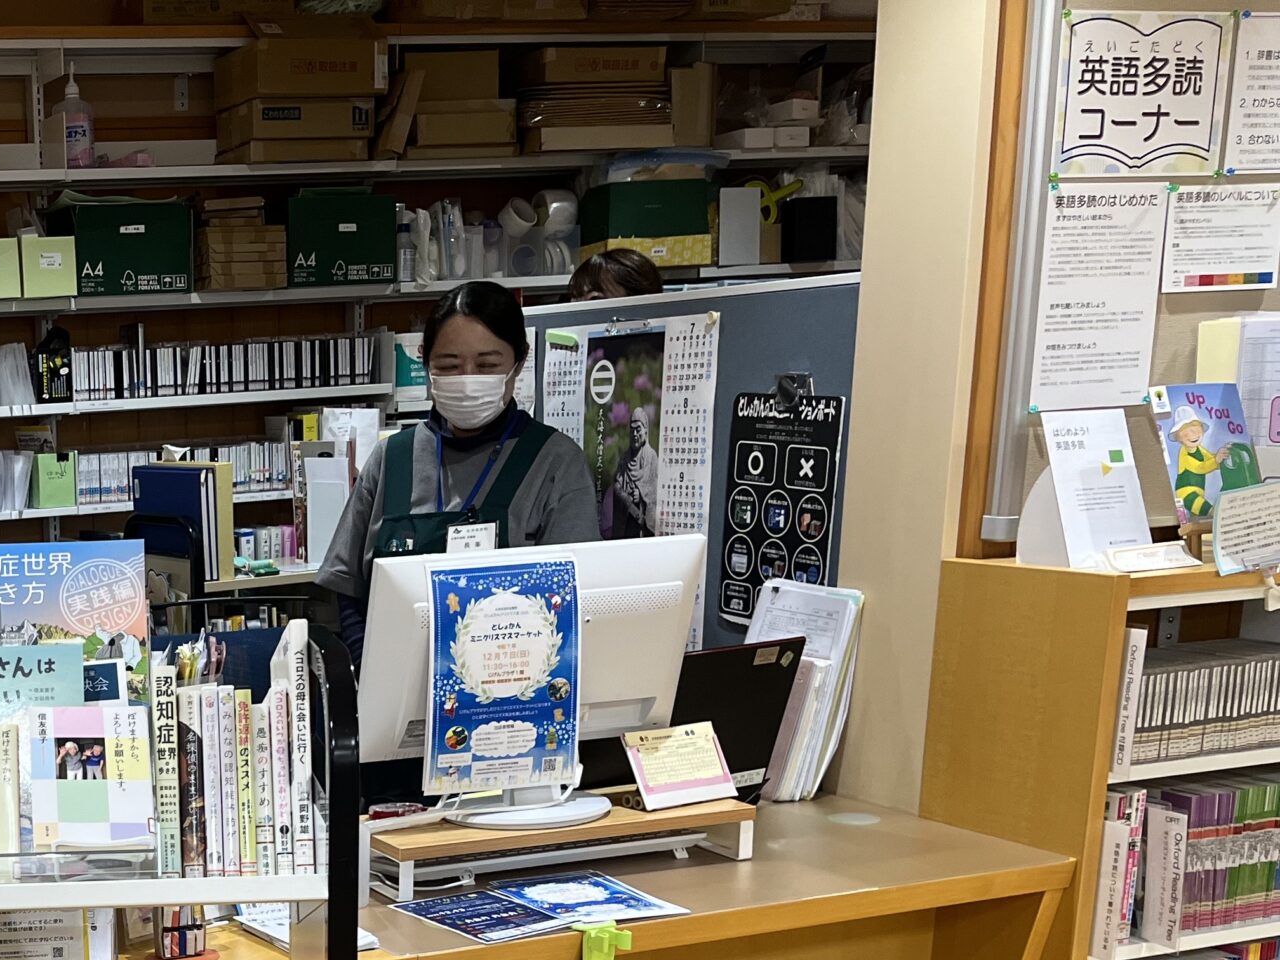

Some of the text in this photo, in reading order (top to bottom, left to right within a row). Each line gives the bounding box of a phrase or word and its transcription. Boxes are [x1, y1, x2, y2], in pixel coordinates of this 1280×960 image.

[1084, 40, 1204, 53] えいごたどく
[1077, 55, 1205, 96] 英語多読
[1078, 103, 1201, 143] コーナー
[1054, 193, 1159, 209] 英語多読のはじめかた
[1176, 189, 1280, 204] 英語多読のレベルについて
[294, 251, 317, 268] A4
[81, 260, 105, 278] A4
[683, 398, 689, 408] 8
[1185, 391, 1205, 409] Up
[1204, 404, 1231, 420] You
[1227, 419, 1244, 435] Go
[679, 472, 684, 482] 9
[68, 563, 122, 592] DIALOGUE
[67, 579, 136, 615] 実践編
[82, 605, 135, 631] DESIGN
[490, 622, 522, 632] としょかん
[469, 630, 543, 644] ミニクリスマスマーケット
[1120, 644, 1139, 733] Oxford Reading Tree
[155, 676, 176, 744] 認知症
[294, 649, 308, 765] ペコロスの母に会いに行く
[37, 713, 48, 744] 信友直子
[127, 712, 140, 763] ぼけますから、
[113, 712, 126, 792] よろしくお願いします。
[157, 746, 177, 762] 世界
[237, 701, 251, 791] 免許返納のススメ
[158, 765, 177, 776] 歩き方
[1165, 832, 1183, 942] Oxford Reading Tree
